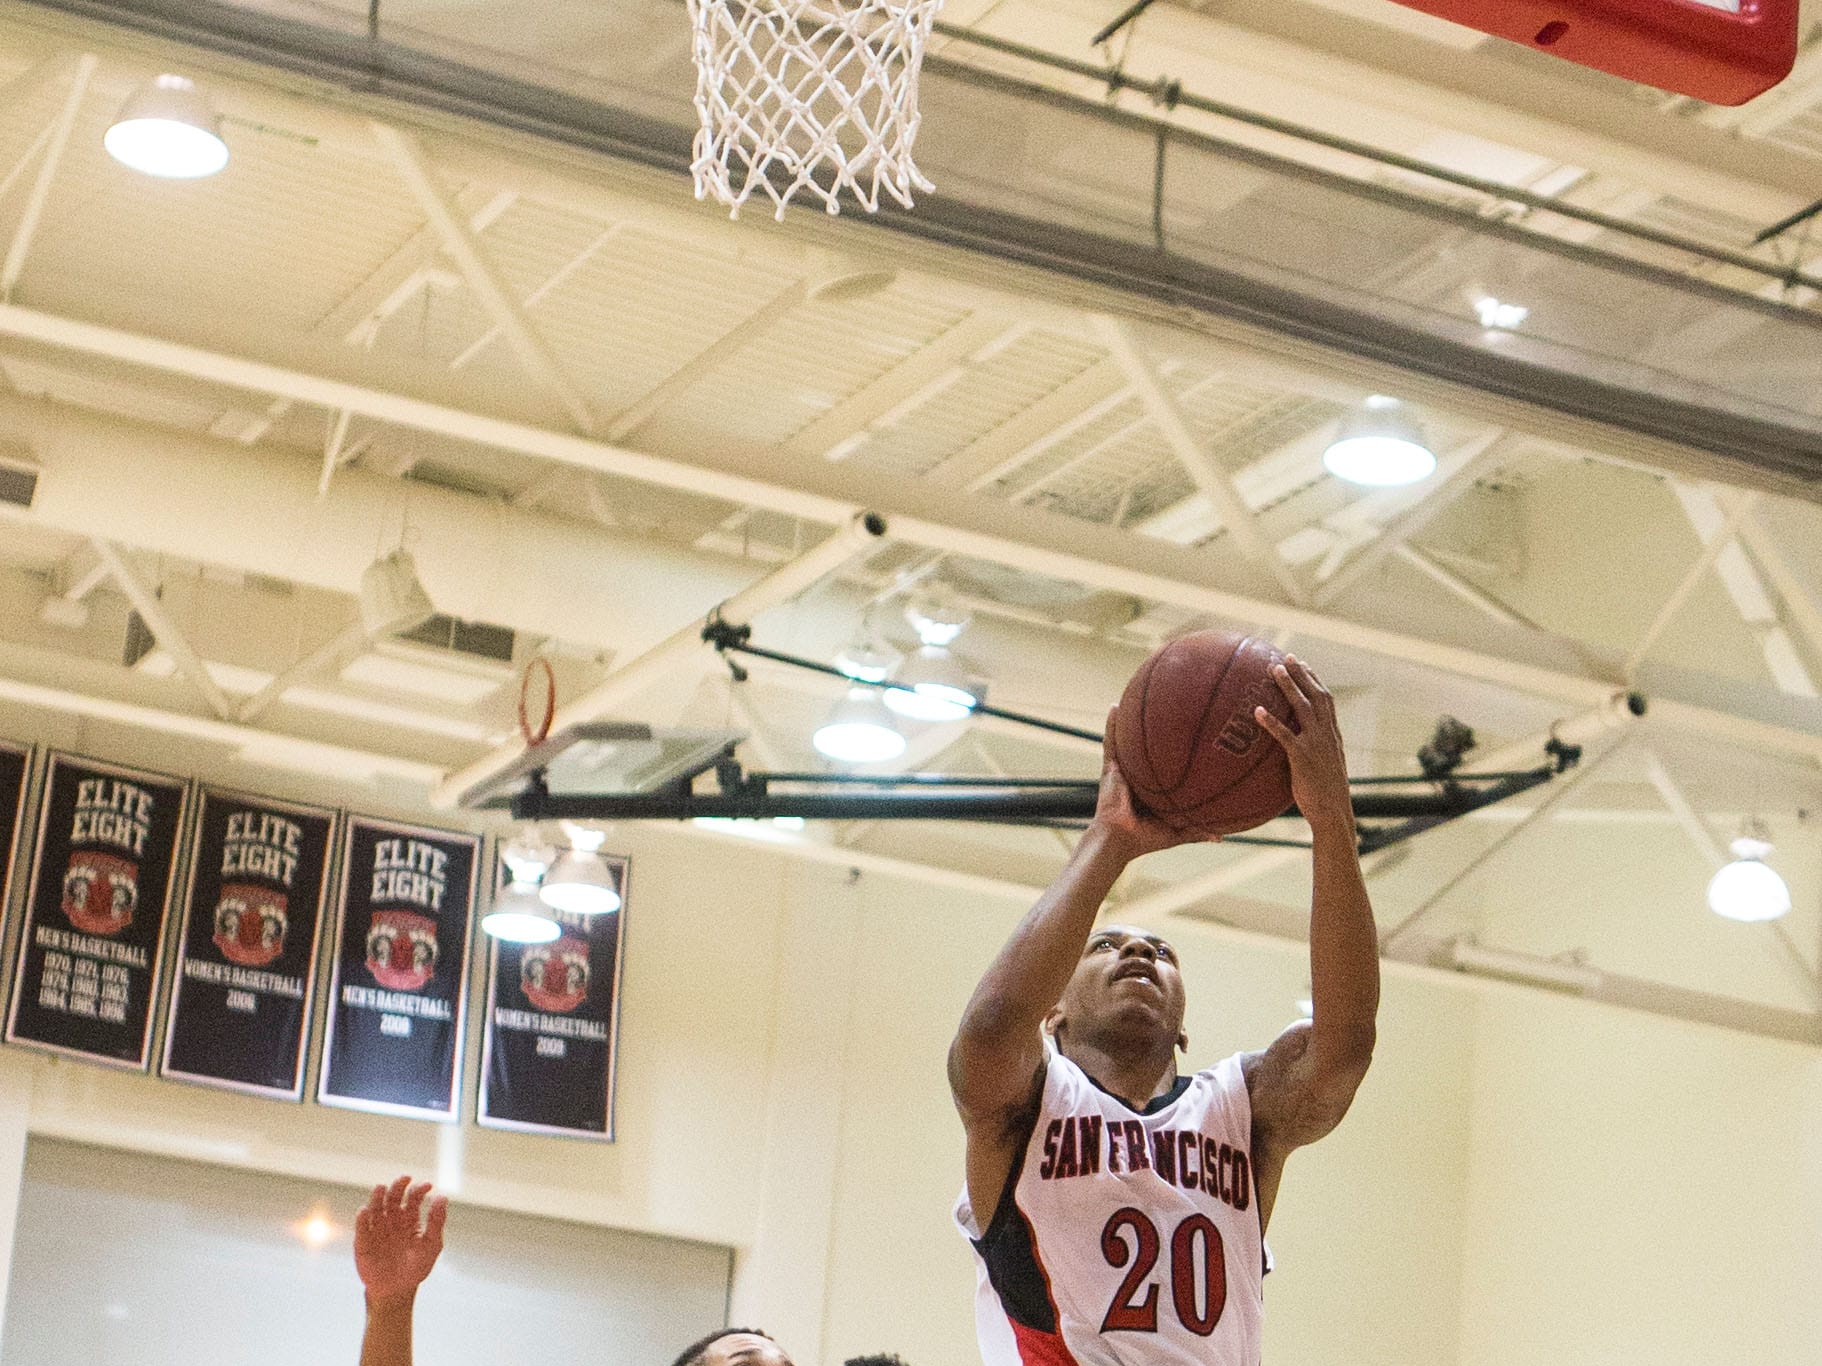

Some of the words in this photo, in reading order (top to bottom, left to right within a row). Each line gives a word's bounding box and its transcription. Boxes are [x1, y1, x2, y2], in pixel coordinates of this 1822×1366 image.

[76, 779, 153, 824] ELITE
[70, 812, 149, 858] EIGHT
[225, 812, 302, 854] ELITE
[221, 843, 297, 886] EIGHT
[374, 839, 447, 880] ELITE
[370, 870, 444, 911] EIGHT
[71, 931, 147, 968] BASKETBALL
[184, 956, 231, 984] WOMEN'S
[231, 965, 303, 999] BASKETBALL
[377, 989, 451, 1019] BASKETBALL
[494, 1006, 540, 1033] WOMEN'S
[540, 1013, 608, 1041] BASKETBALL
[1040, 1115, 1101, 1180] SAN
[1107, 1119, 1249, 1211] FRNCISCO
[1100, 1206, 1227, 1337] 20
